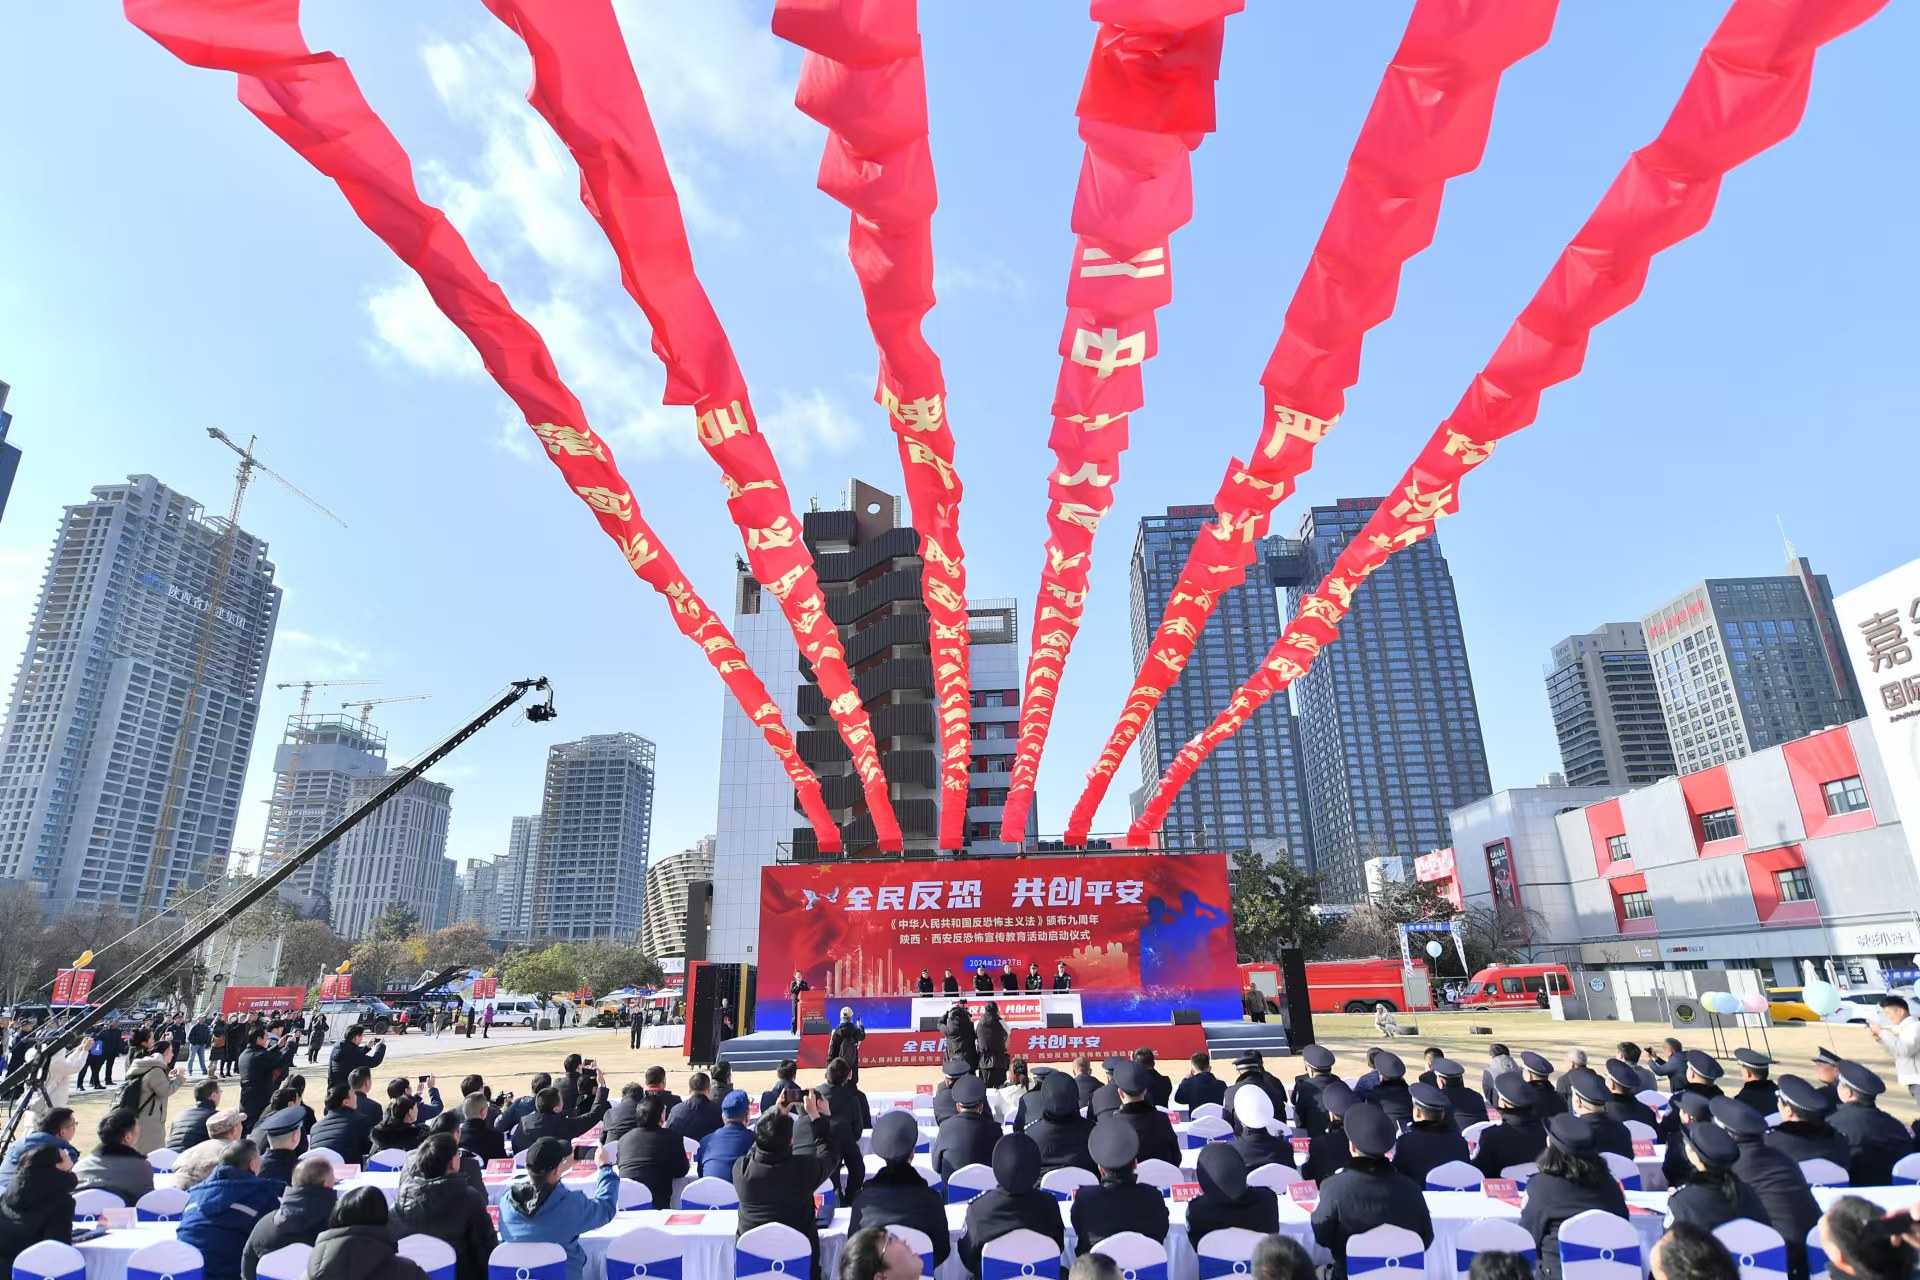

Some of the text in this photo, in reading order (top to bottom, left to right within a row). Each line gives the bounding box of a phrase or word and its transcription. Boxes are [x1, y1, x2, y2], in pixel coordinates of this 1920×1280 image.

[843, 876, 1144, 911] 全民反恐 共创平安
[1028, 1034, 1101, 1050] 共创平安
